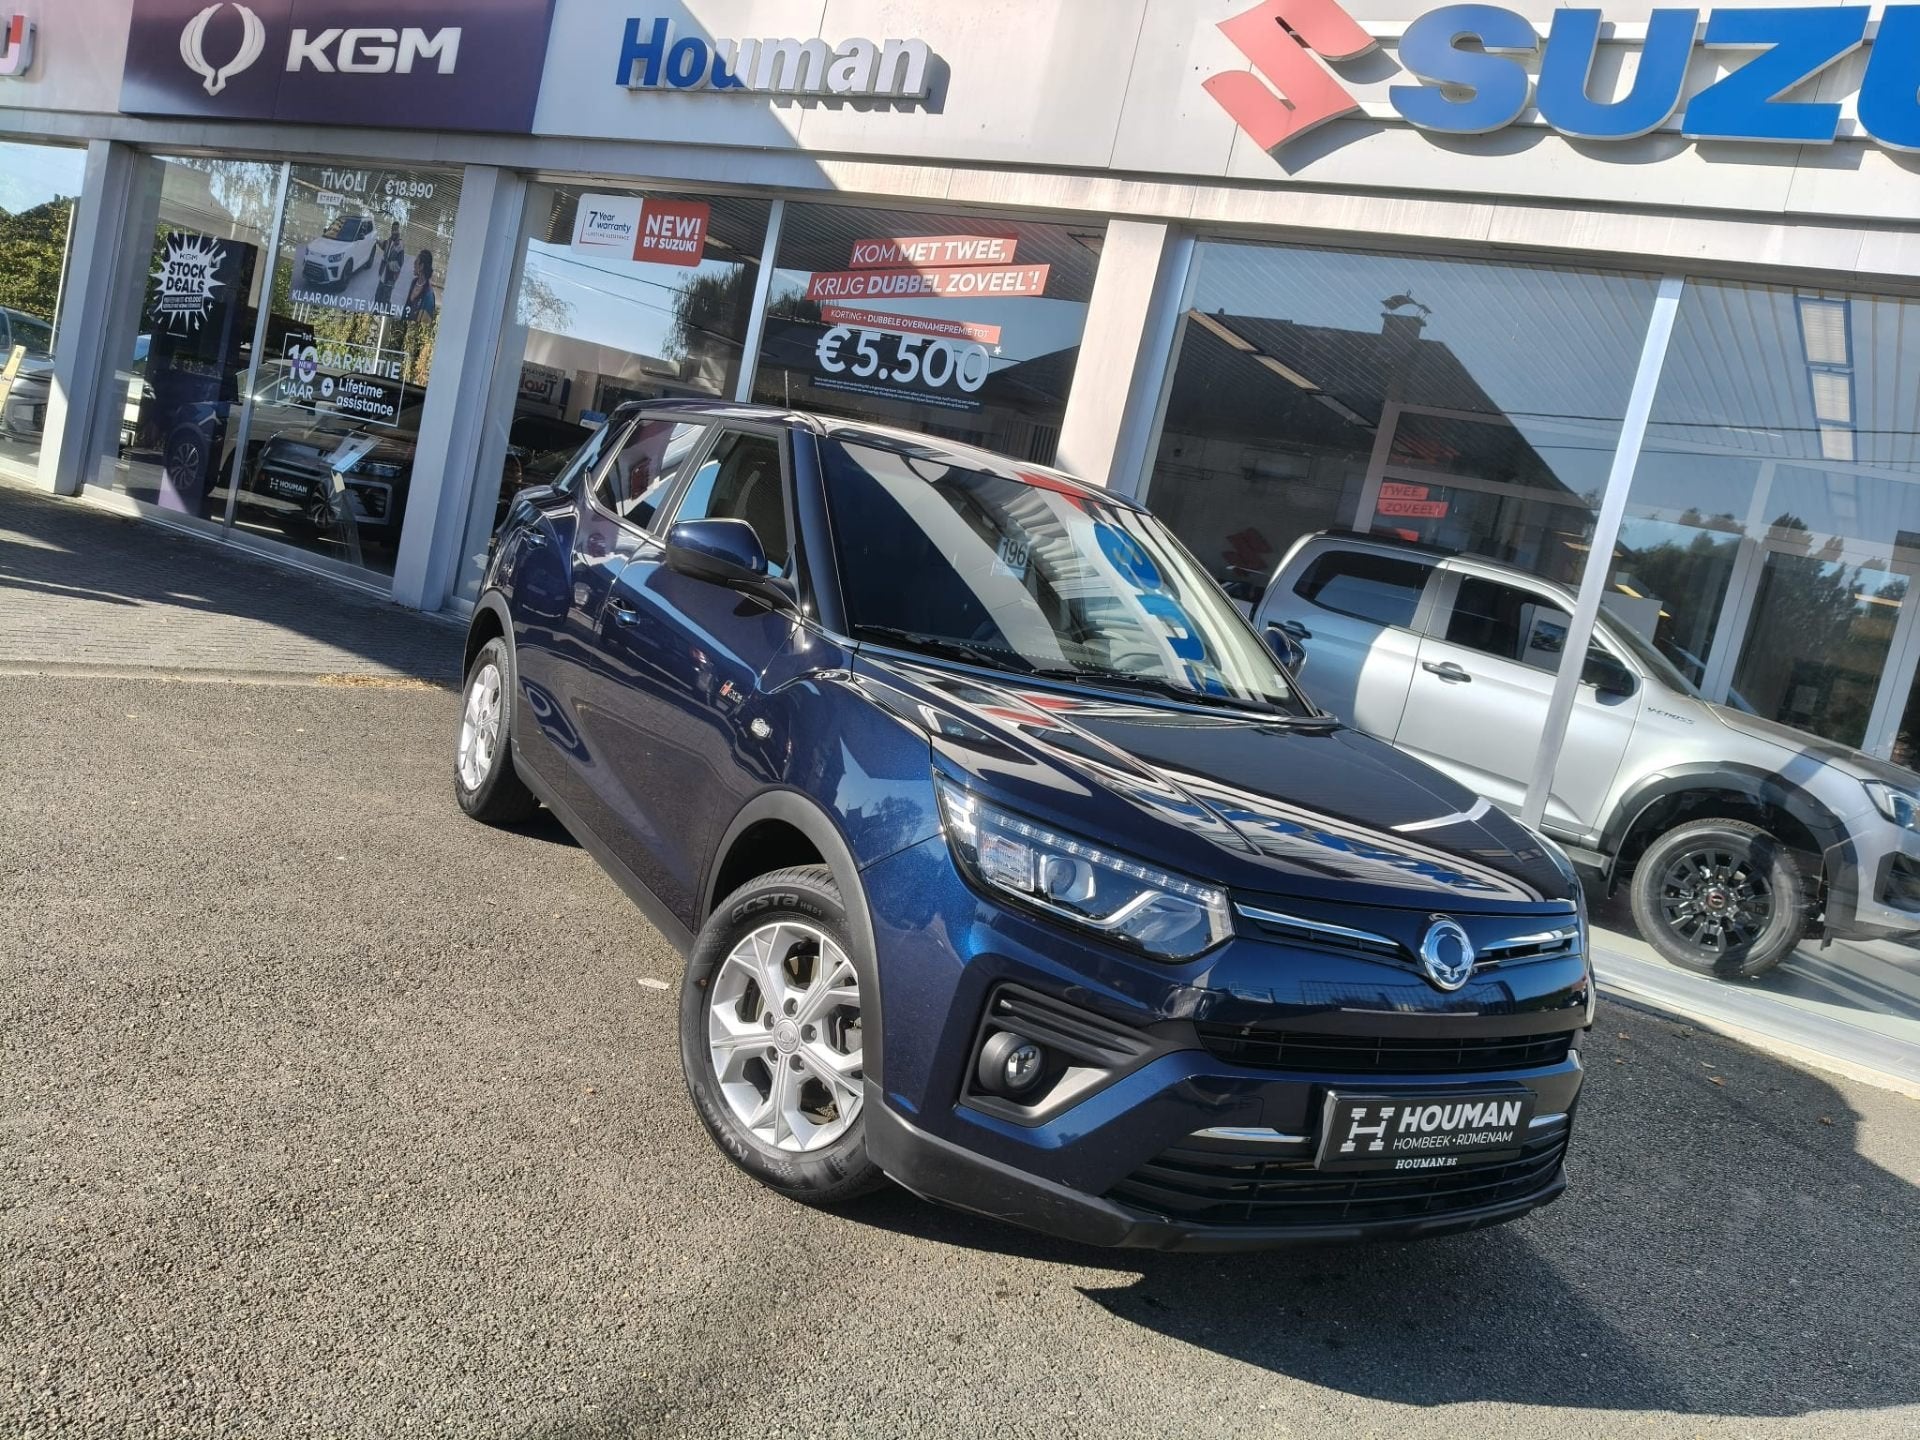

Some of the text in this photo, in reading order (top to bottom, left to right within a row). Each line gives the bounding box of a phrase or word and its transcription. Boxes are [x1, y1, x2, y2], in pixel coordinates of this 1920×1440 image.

[285, 26, 462, 74] KGM
[615, 17, 932, 97] Houman
[321, 170, 368, 193] TIVOLI
[588, 210, 615, 228] 7 Year
[596, 222, 631, 235] warranty
[645, 214, 702, 240] NEW!
[643, 237, 697, 252] BY SUZUKI
[852, 239, 1006, 263] KOM MET TWEE,
[180, 253, 198, 261] KGM
[168, 261, 208, 279] STOCK
[813, 277, 865, 296] KRIJG
[866, 274, 943, 294] DUBBEL
[291, 289, 411, 318] KLAAR OM OP TE VALLEN ?
[830, 309, 862, 321] KORTING
[867, 314, 901, 327] DUBBELE
[901, 319, 972, 336] OVERNAMEPREMIE
[973, 328, 989, 338] TOT
[288, 344, 318, 383] 10
[321, 352, 402, 380] GARANTIE
[283, 382, 314, 399] JAAR
[338, 378, 384, 398] Lifetime
[336, 395, 394, 416] assistance
[1002, 539, 1026, 566] 196
[1398, 1101, 1522, 1133] HOUMAN
[1393, 1131, 1514, 1150] HOMBEEK RIJMENAM
[1395, 1156, 1458, 1170] HOUMAN.BE
